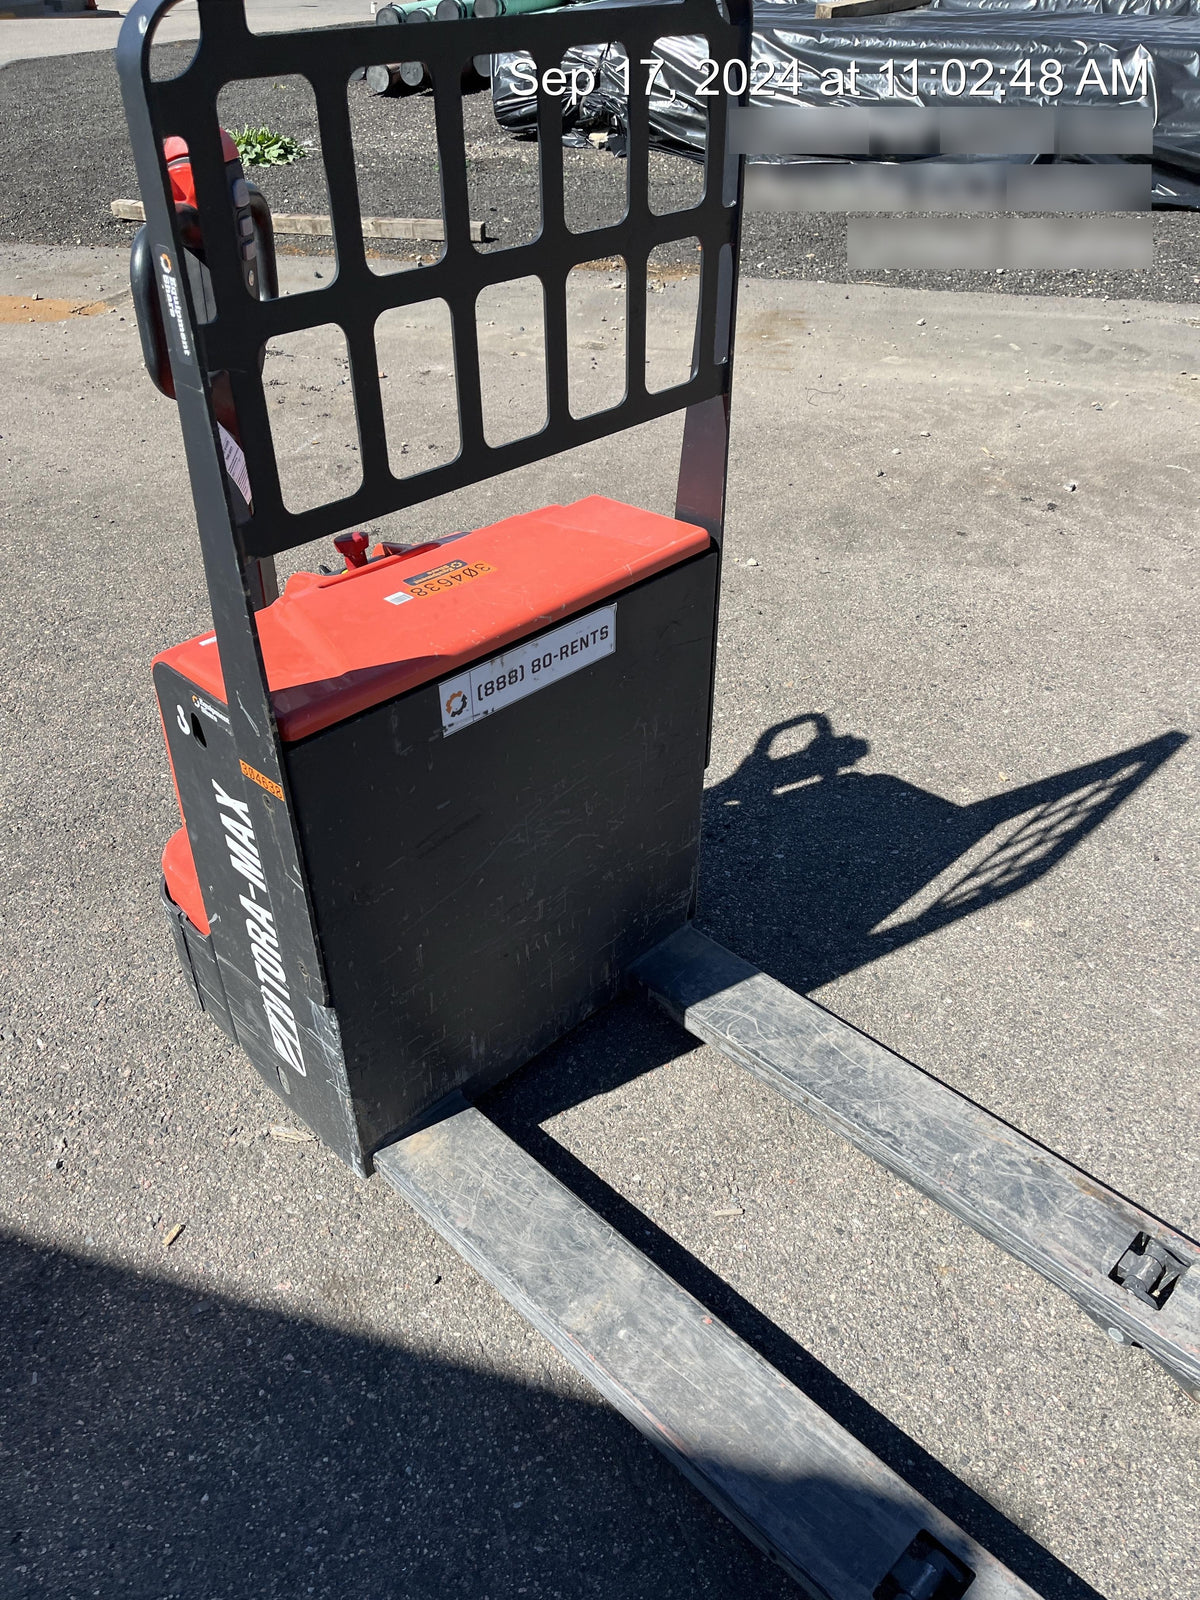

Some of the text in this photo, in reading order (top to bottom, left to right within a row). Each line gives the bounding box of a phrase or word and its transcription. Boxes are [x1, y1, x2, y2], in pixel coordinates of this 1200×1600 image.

[410, 563, 491, 597] 304638
[477, 625, 609, 701] (888) 80-RENTS
[211, 778, 291, 1001] TORA-MAX
